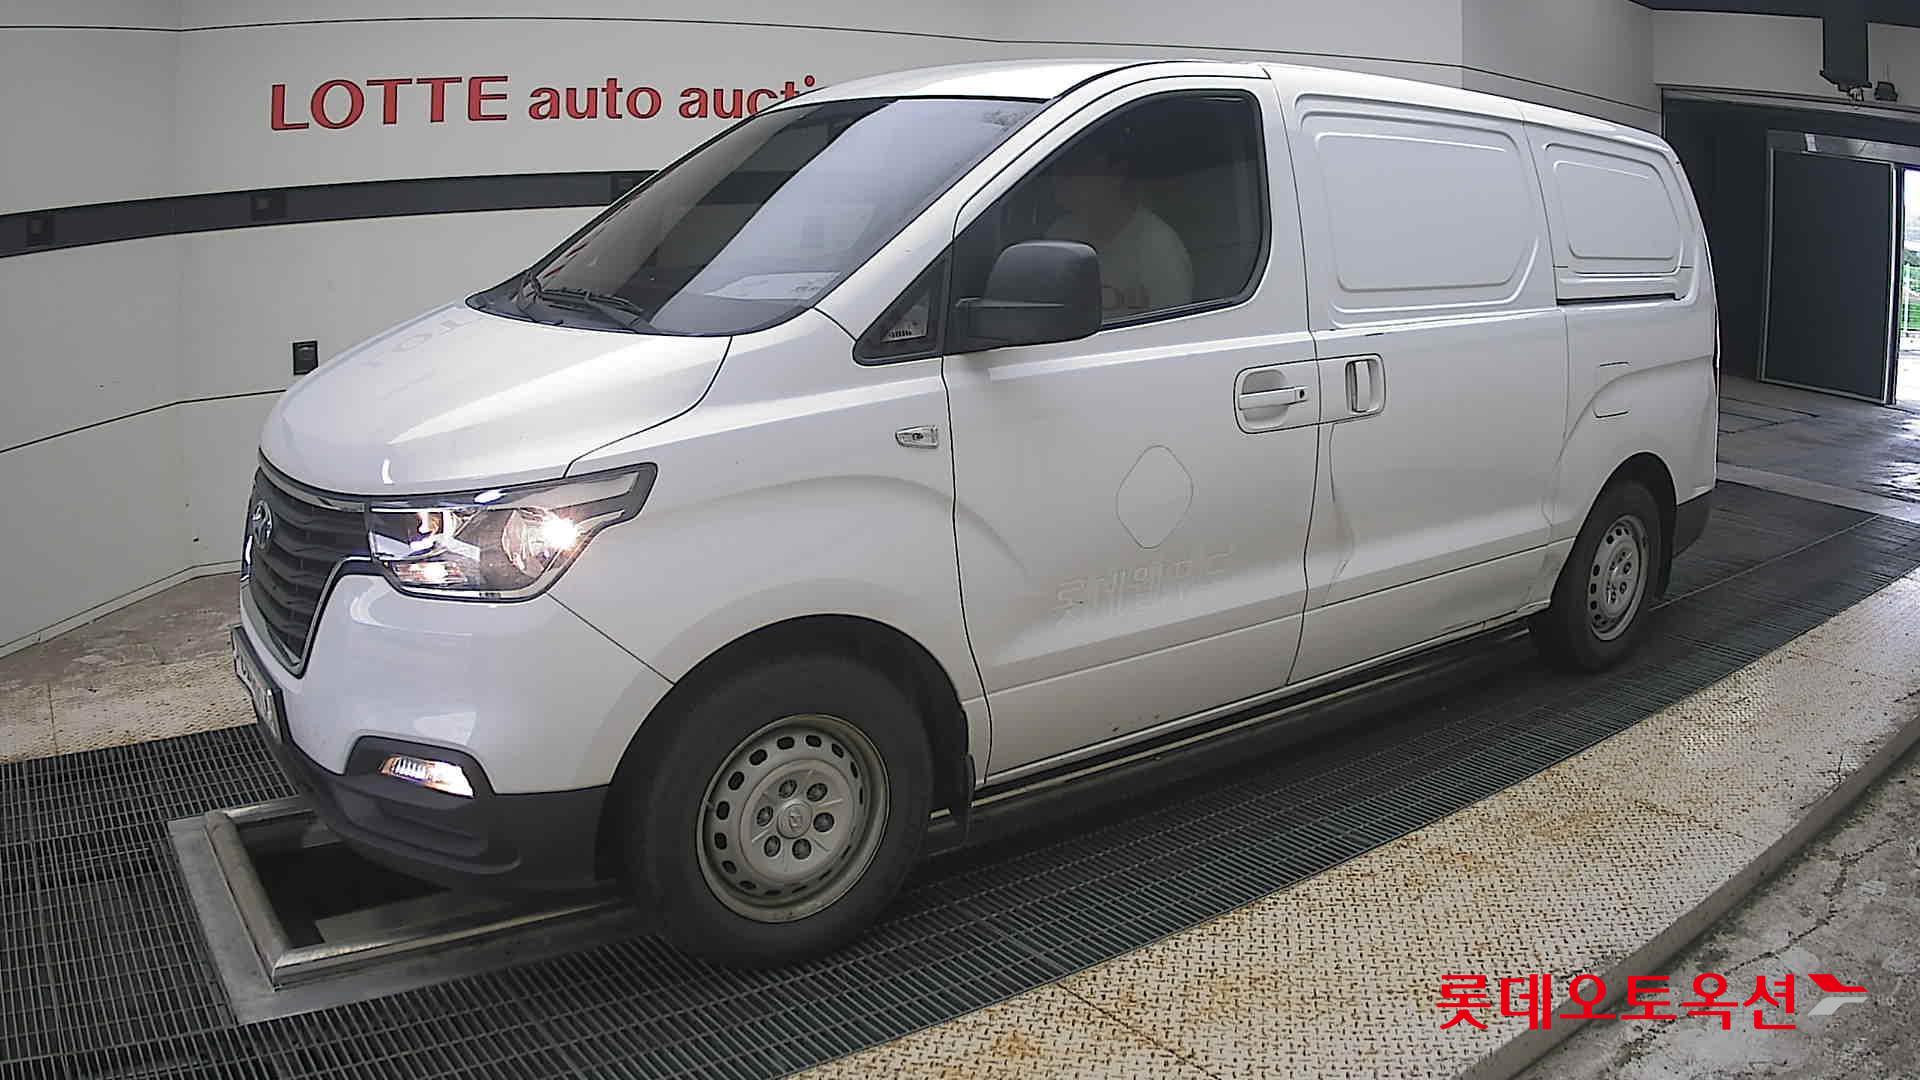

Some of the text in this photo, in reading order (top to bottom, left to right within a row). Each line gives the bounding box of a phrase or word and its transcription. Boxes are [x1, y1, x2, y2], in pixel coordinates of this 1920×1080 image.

[271, 75, 816, 131] LOTTE auto auct
